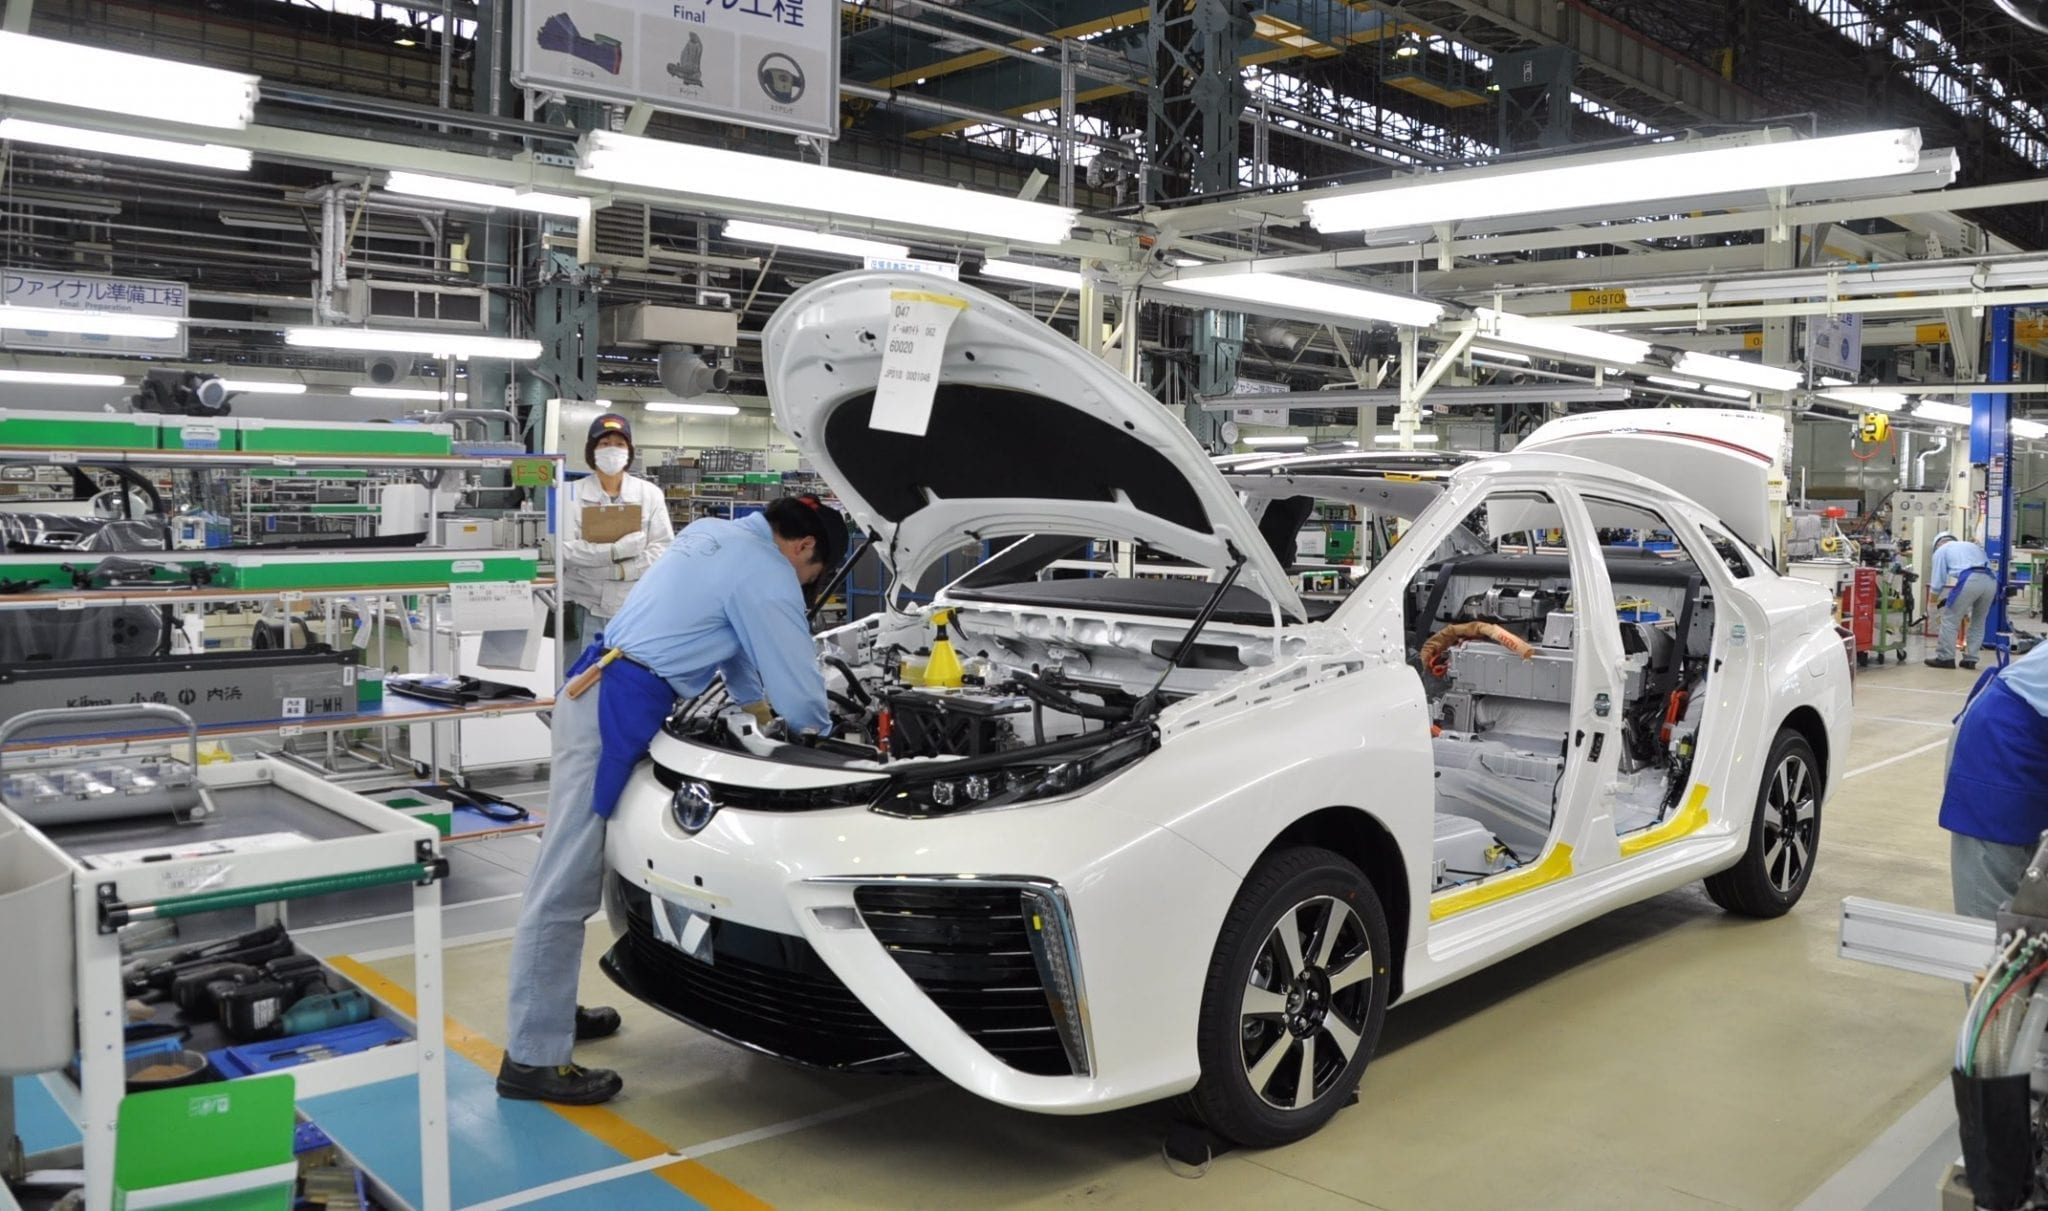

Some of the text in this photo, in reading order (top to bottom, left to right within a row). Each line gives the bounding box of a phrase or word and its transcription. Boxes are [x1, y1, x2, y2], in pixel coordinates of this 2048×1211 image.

[673, 4, 706, 24] Final
[3, 275, 184, 307] ファイナル準備工程
[59, 299, 80, 308] Final
[895, 305, 911, 319] 047
[889, 340, 914, 354] 60020
[305, 697, 343, 714] U-MH
